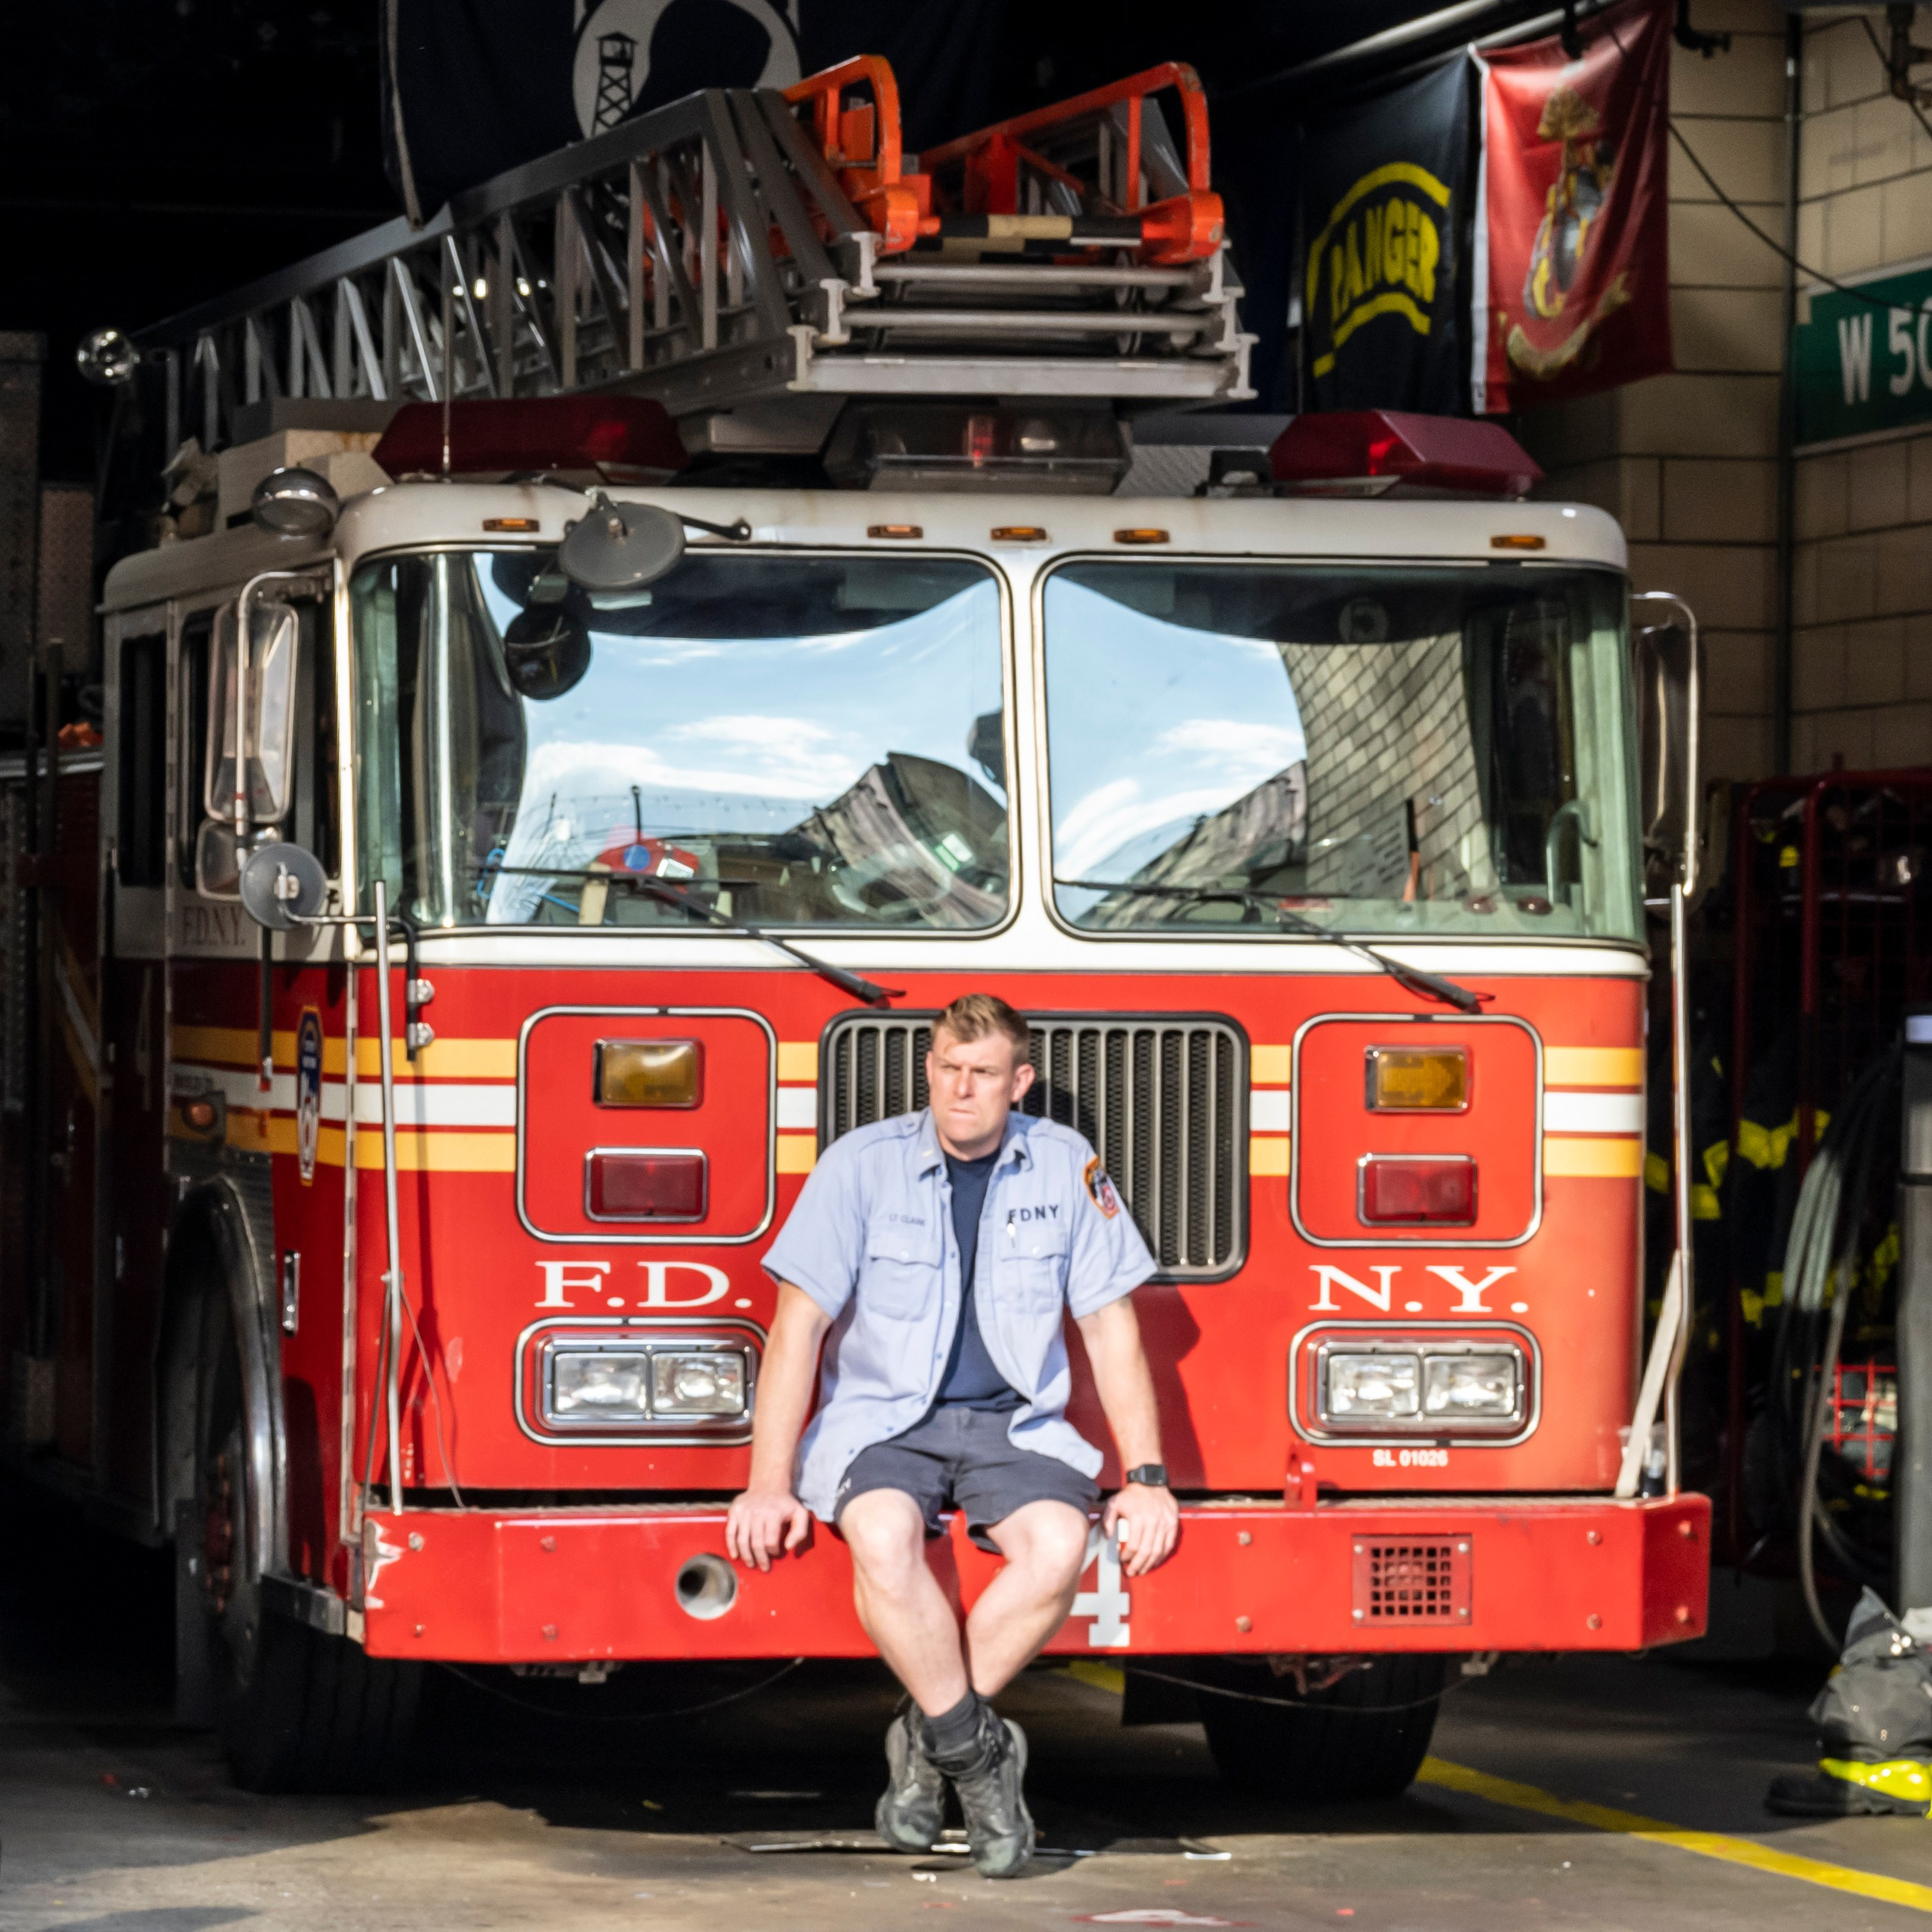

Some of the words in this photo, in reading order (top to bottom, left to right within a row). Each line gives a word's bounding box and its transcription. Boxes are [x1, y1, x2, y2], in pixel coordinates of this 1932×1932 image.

[1837, 312, 1873, 405] W
[1008, 1204, 1059, 1223] FDNY
[534, 1260, 752, 1309] F.D.
[1308, 1265, 1529, 1313] N.Y.
[1373, 1449, 1396, 1467] SL
[1069, 1518, 1130, 1647] 4
